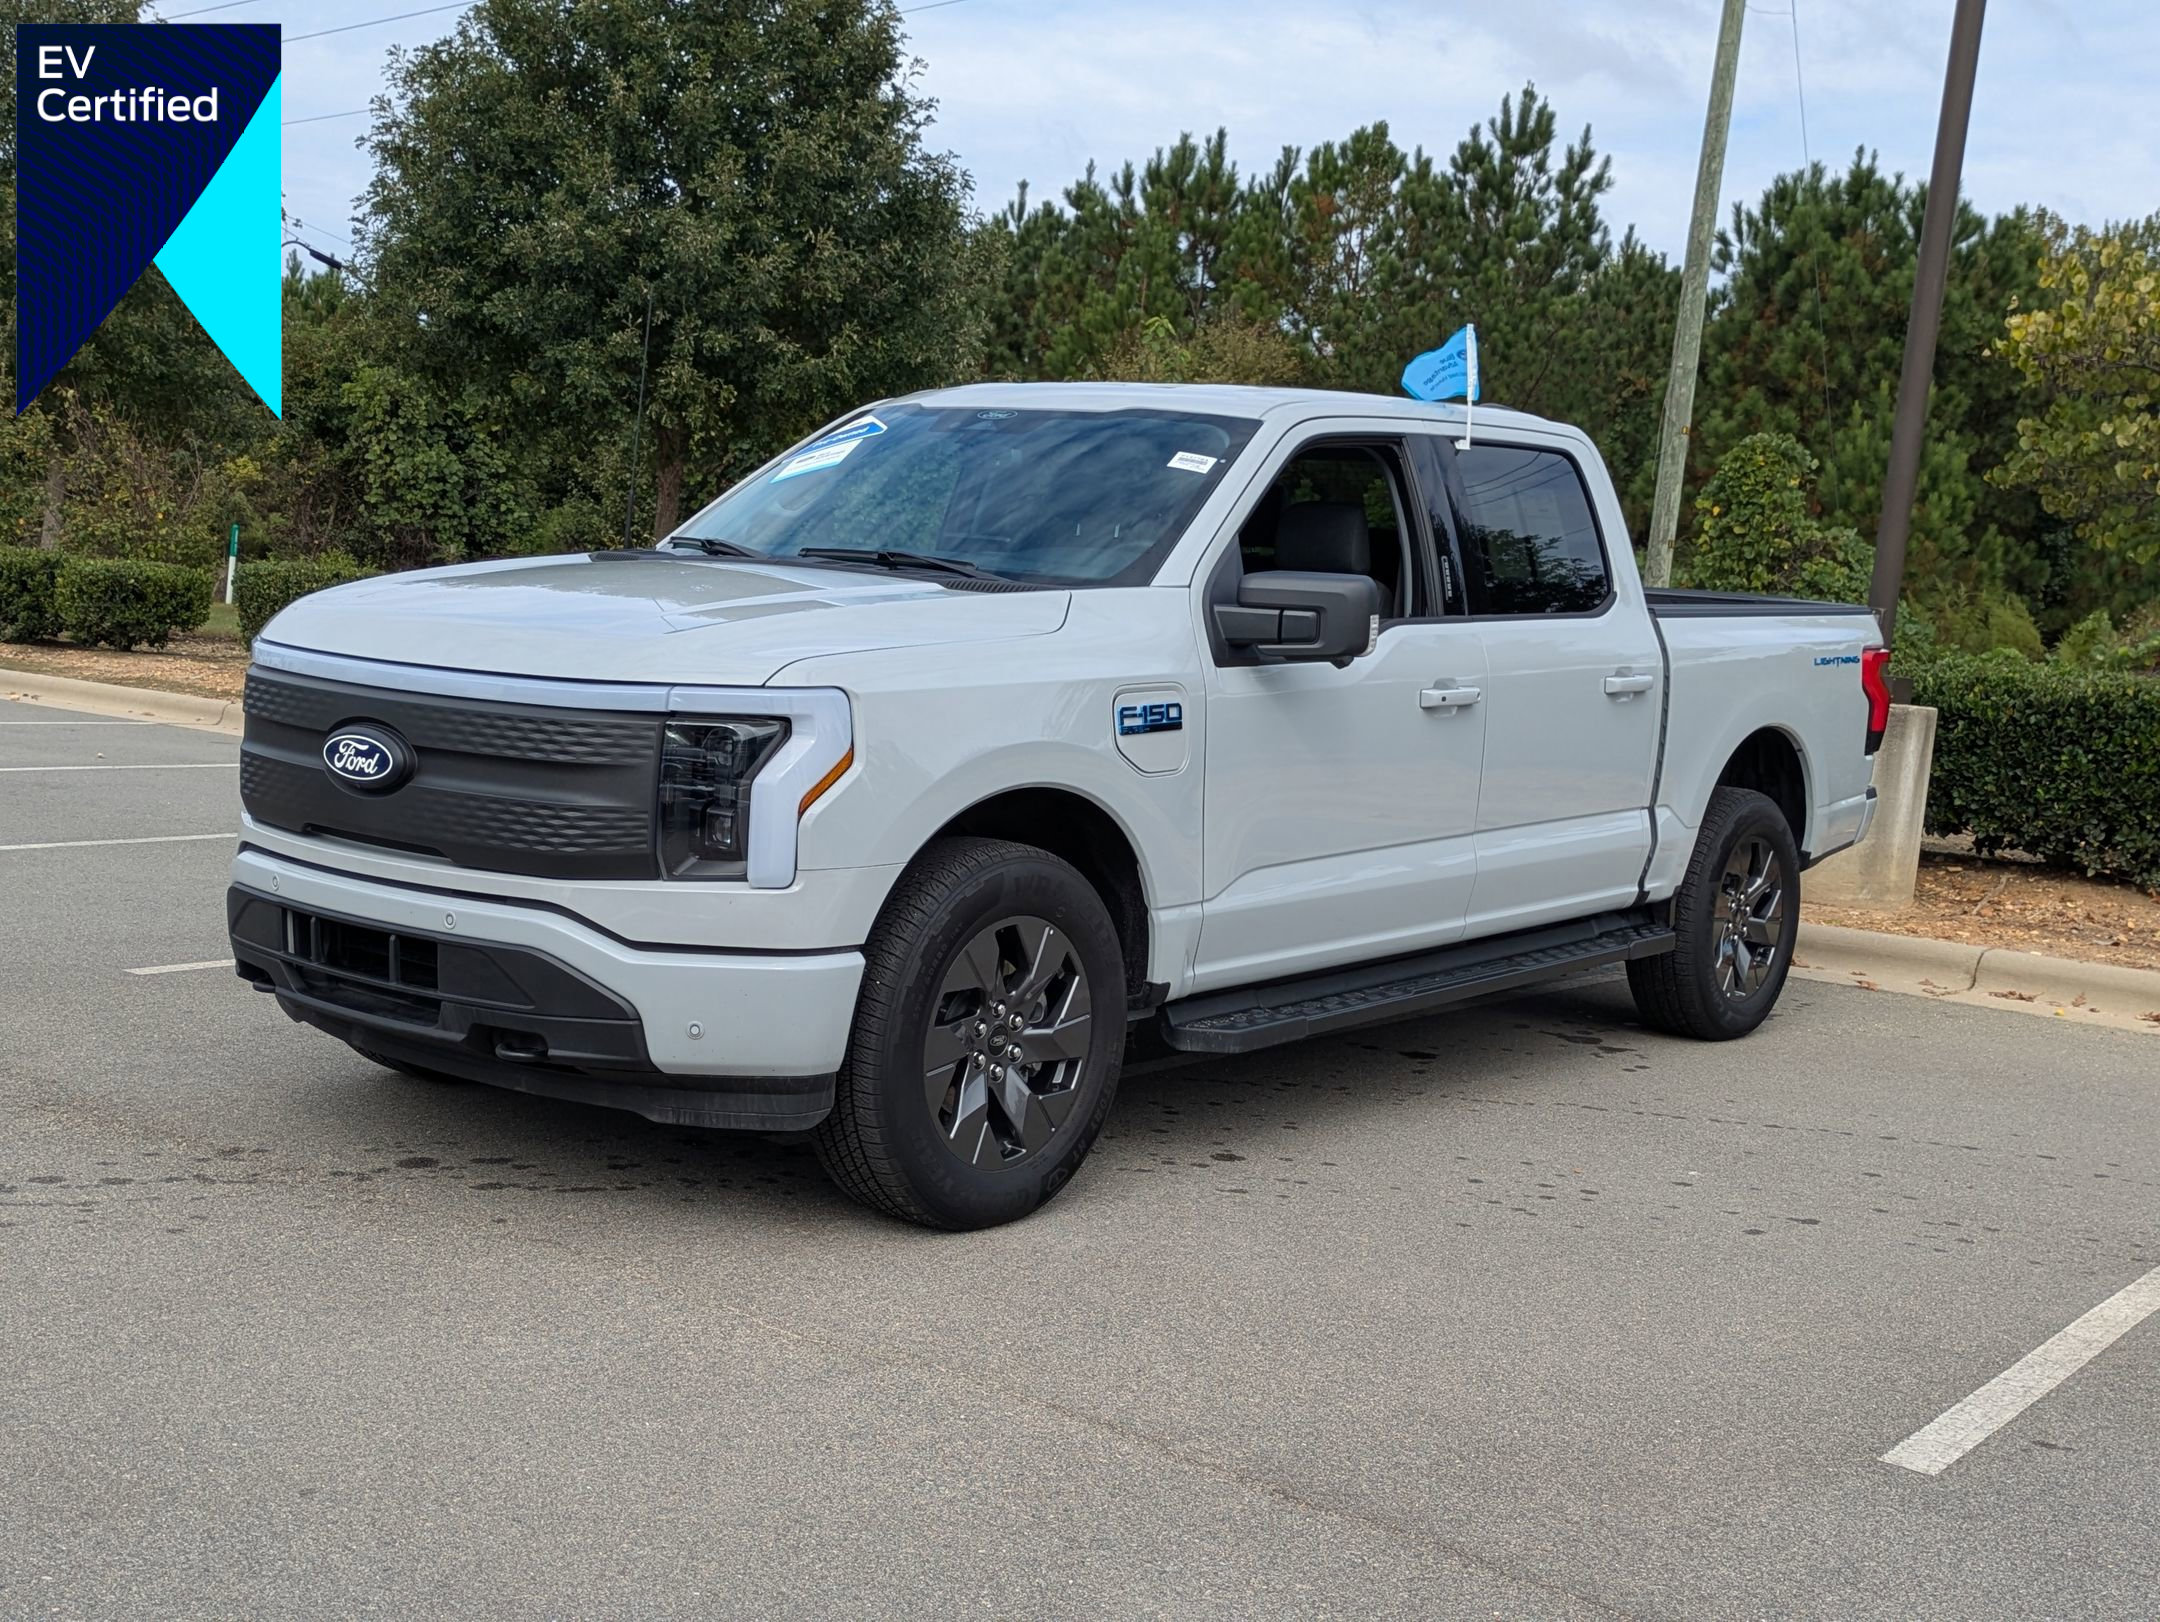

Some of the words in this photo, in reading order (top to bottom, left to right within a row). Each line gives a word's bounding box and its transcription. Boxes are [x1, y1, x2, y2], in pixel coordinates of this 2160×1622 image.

[1813, 655, 1860, 667] LIGHTNING
[1118, 702, 1183, 726] F-150
[333, 739, 380, 774] Ford
